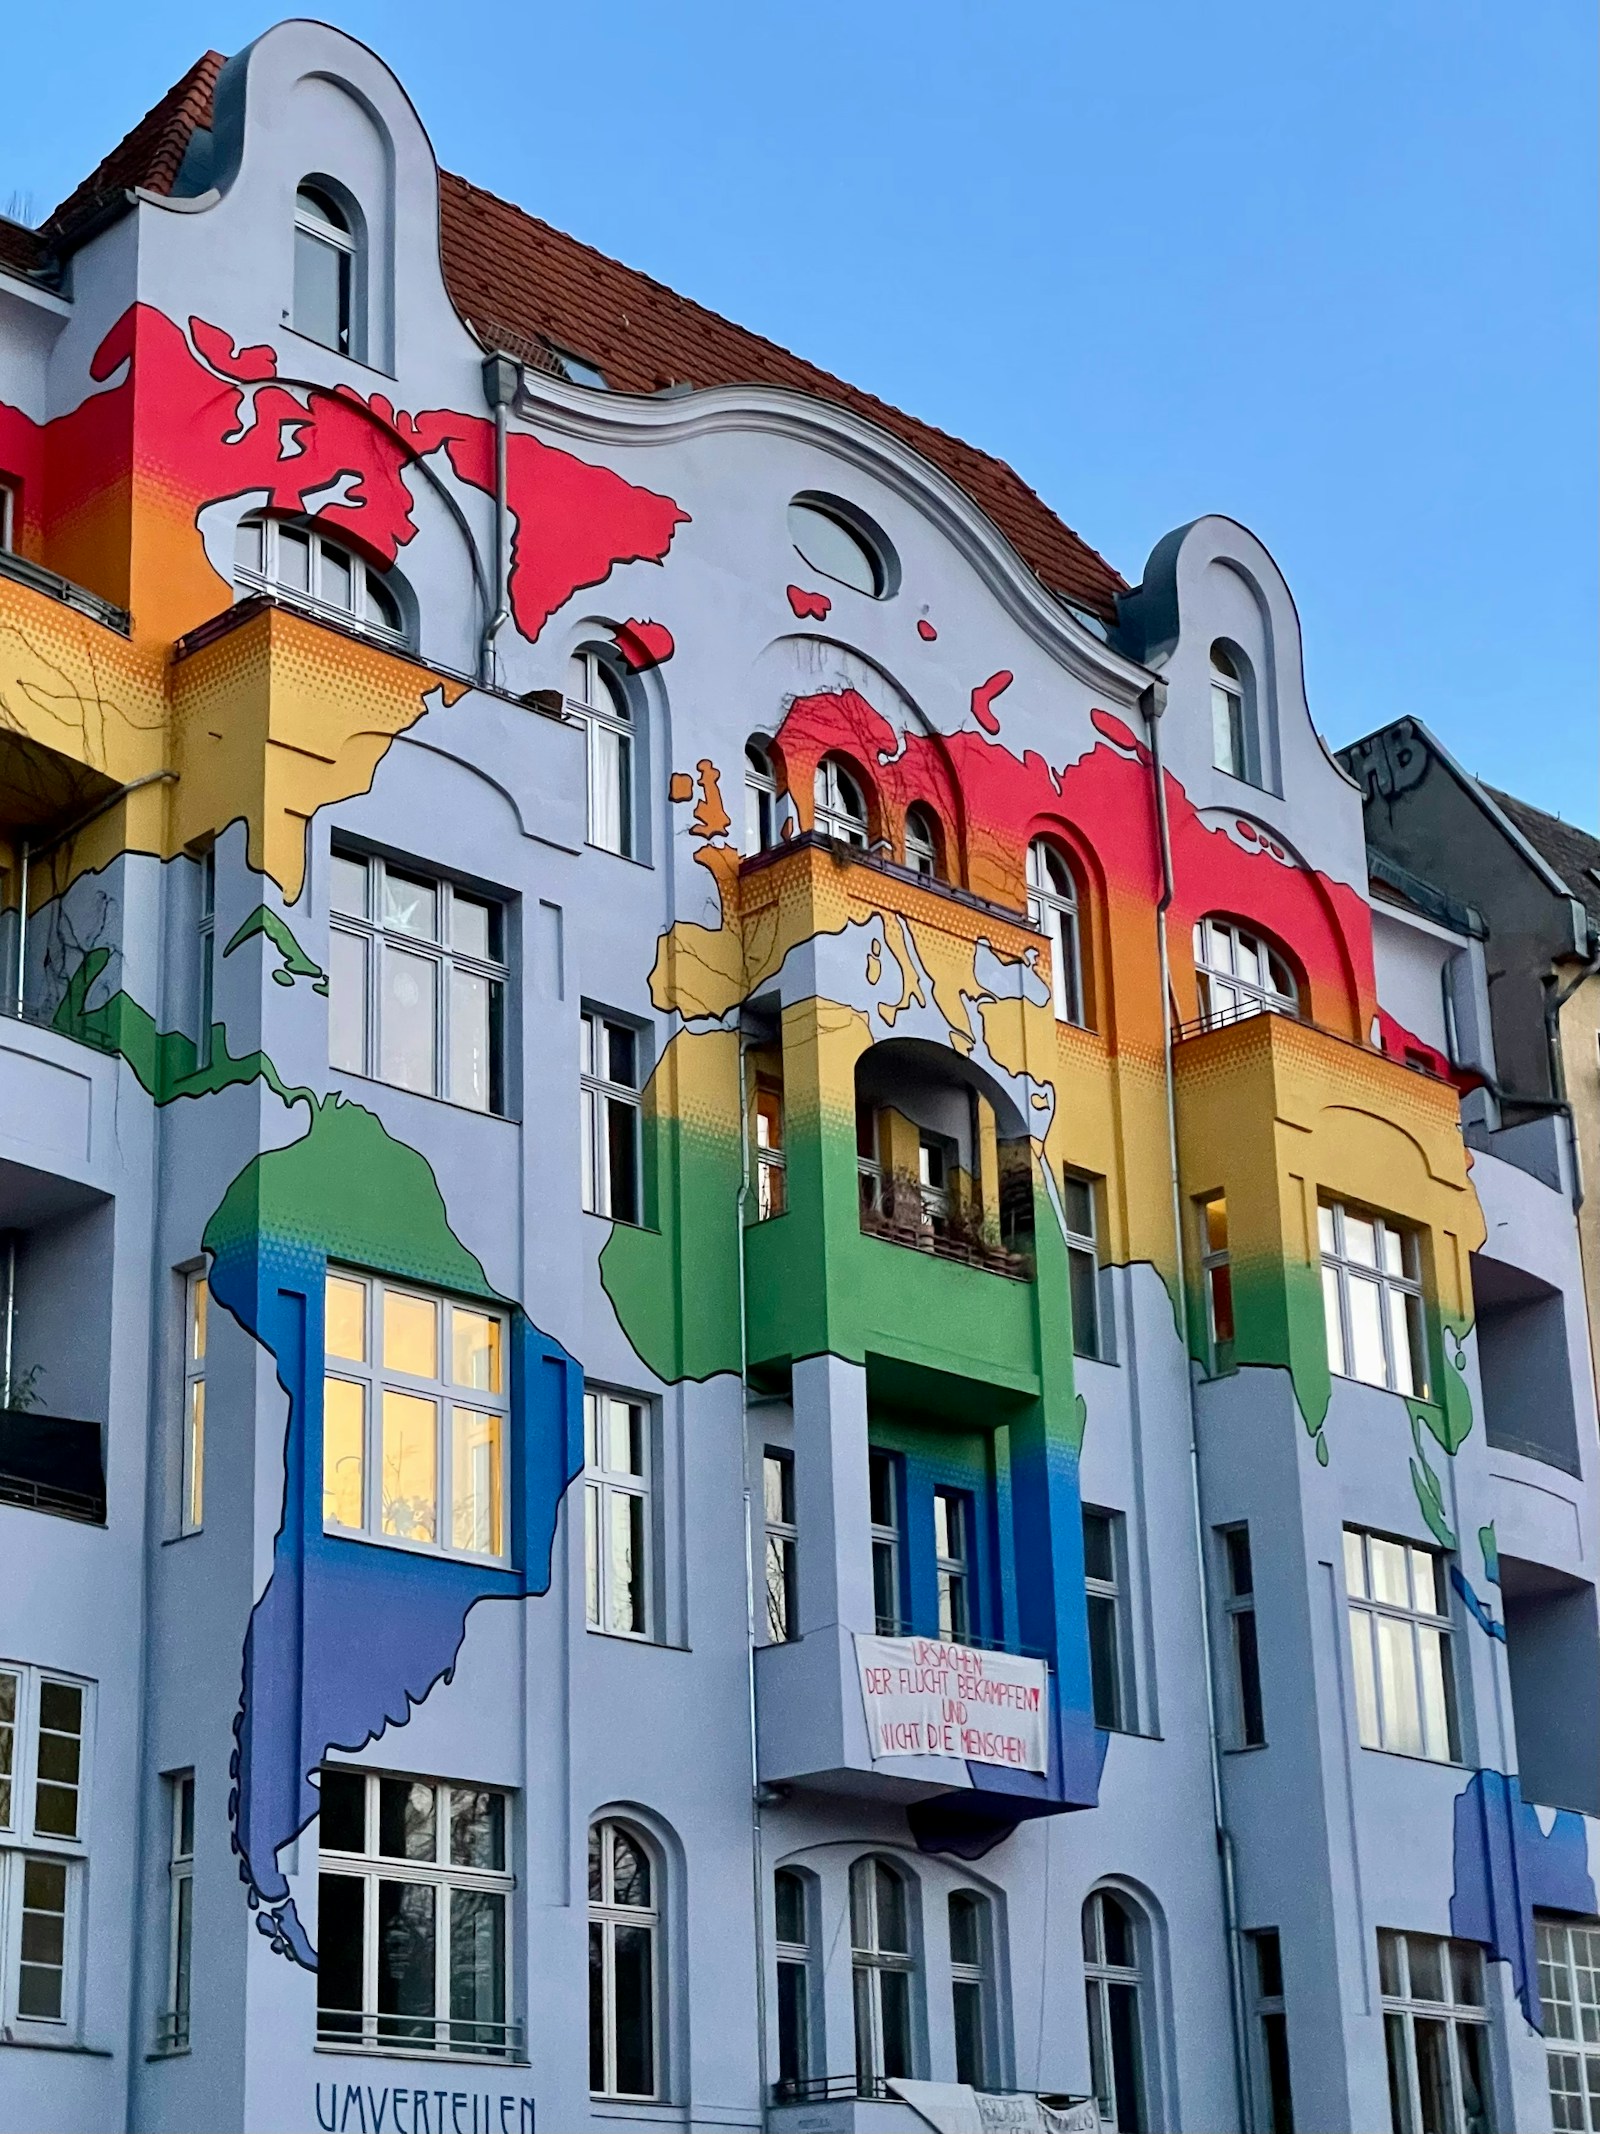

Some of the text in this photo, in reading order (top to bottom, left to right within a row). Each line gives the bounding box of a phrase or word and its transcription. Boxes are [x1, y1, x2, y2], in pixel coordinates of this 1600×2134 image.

[912, 1641, 983, 1676] URSACHEN
[866, 1668, 892, 1695] DER
[899, 1668, 949, 1696] FLUCHT
[941, 1700, 968, 1725] UND
[927, 1723, 955, 1752] DIE
[960, 1728, 1027, 1763] MENSCHEN
[316, 2082, 536, 2134] UMVERTEILEN
